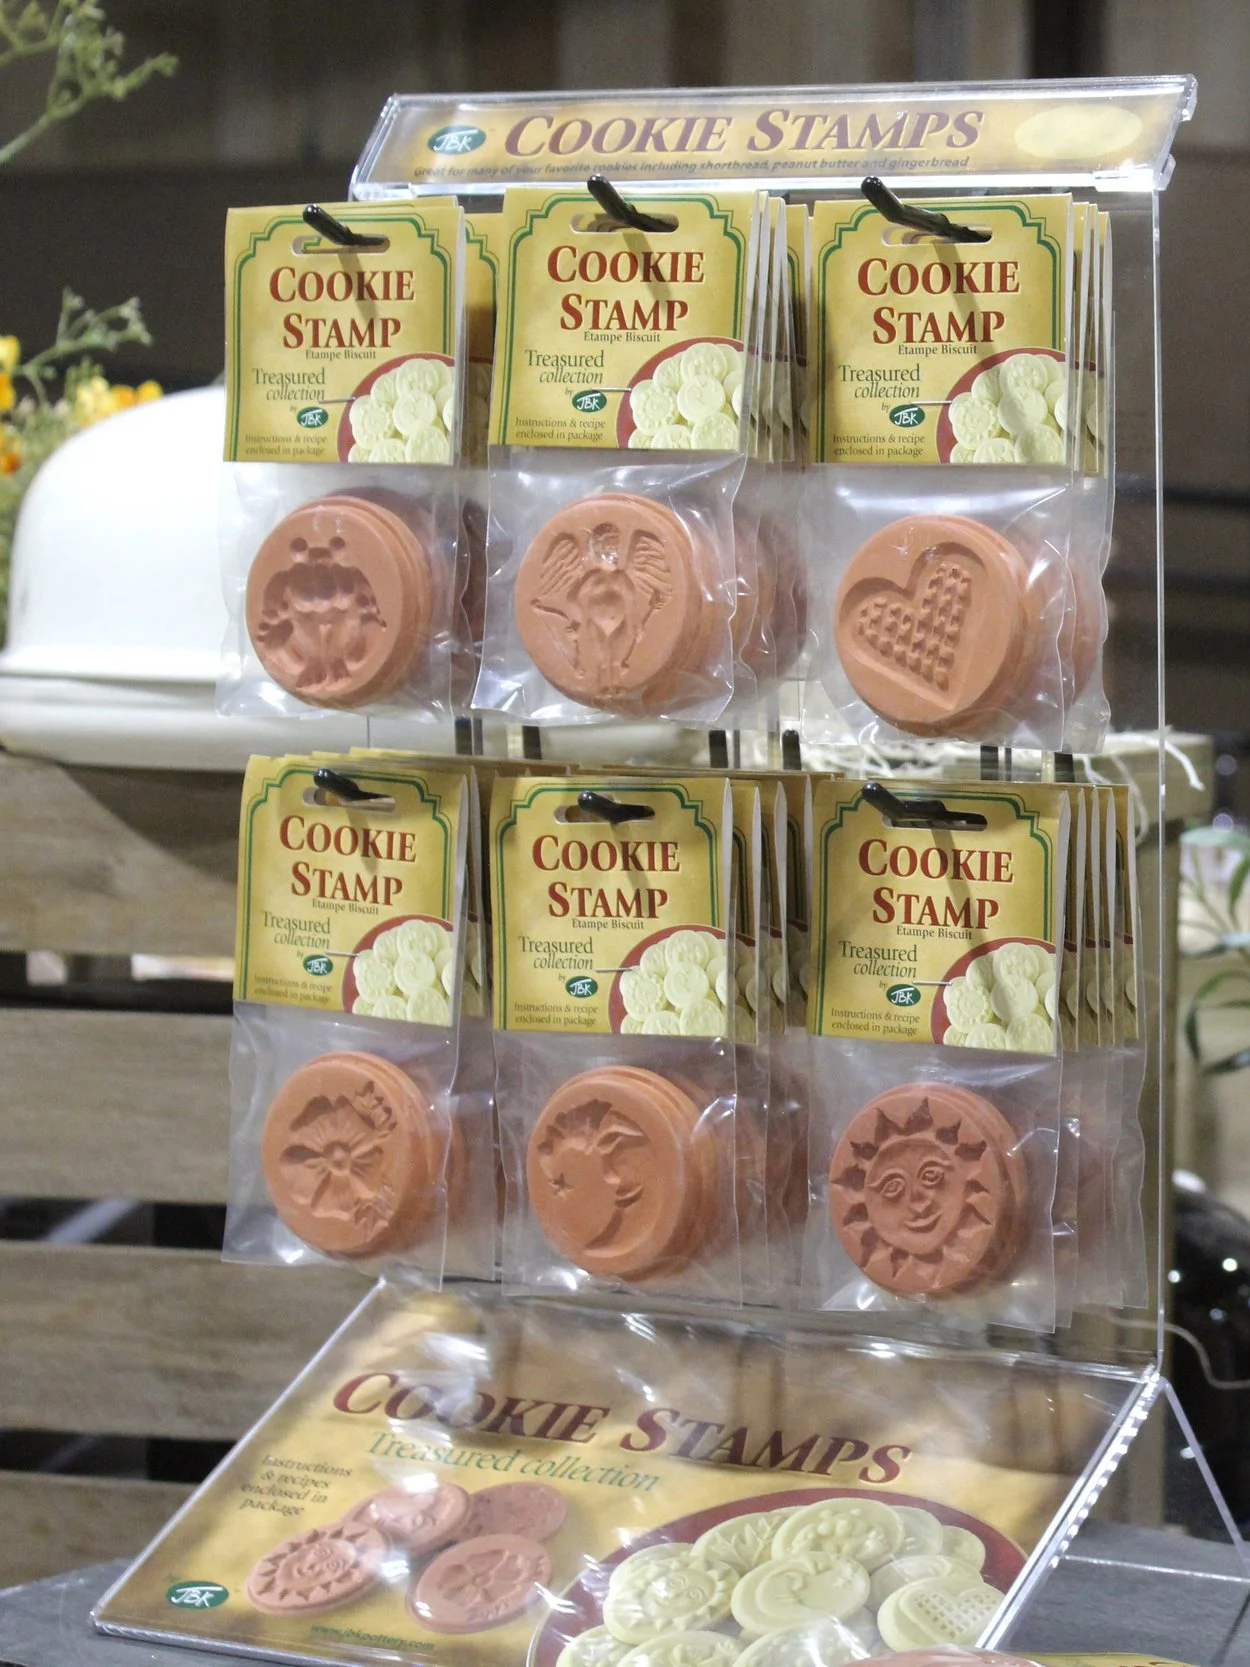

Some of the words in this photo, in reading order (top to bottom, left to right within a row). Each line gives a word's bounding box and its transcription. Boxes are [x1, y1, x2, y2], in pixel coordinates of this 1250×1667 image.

[433, 129, 480, 153] JBK
[505, 114, 732, 157] COOKIE
[747, 110, 984, 151] STAMPS
[545, 162, 591, 174] favorite
[593, 161, 637, 173] cookies
[640, 160, 697, 173] including
[772, 159, 817, 172] peanut
[820, 157, 858, 169] butter
[862, 157, 885, 169] and
[889, 156, 970, 170] gingerbread
[547, 245, 705, 283] COOKIE
[269, 266, 415, 303] COOKIE
[857, 258, 1020, 296] COOKIE
[560, 293, 688, 332] STAMP
[283, 313, 402, 349] STAMP
[873, 306, 1005, 345] STAMP
[625, 331, 661, 342] Biscuit
[344, 349, 376, 360] Biscuit
[524, 349, 604, 367] Treasured
[941, 344, 977, 354] Biscuit
[251, 367, 326, 385] Treasured
[539, 365, 603, 384] collection
[838, 363, 921, 381] Treasured
[266, 382, 325, 400] collection
[854, 381, 920, 399] collection
[575, 392, 603, 411] JBK
[298, 408, 325, 426] JBK
[515, 417, 567, 428] Instructions
[569, 417, 577, 427] &
[579, 417, 605, 430] recipe
[893, 406, 920, 425] JBK
[516, 429, 556, 440] enclosed
[558, 430, 566, 440] in
[567, 430, 603, 442] package
[832, 433, 885, 443] Instructions
[888, 434, 896, 443] &
[898, 433, 925, 446] recipe
[834, 445, 873, 456] enclosed
[875, 446, 884, 456] in
[887, 446, 923, 457] package
[279, 815, 417, 863] COOKIE
[532, 834, 681, 872] COOKIE
[858, 838, 1014, 883] COOKIE
[290, 861, 403, 907] STAMP
[348, 903, 379, 915] Biscuit
[548, 881, 668, 919] STAMP
[872, 886, 999, 931] STAMP
[262, 911, 330, 934] Treasured
[611, 919, 644, 930] Biscuit
[274, 927, 330, 949] collection
[938, 928, 972, 940] Biscuit
[517, 935, 593, 954] Treasured
[838, 940, 918, 962] Treasured
[306, 957, 330, 975] JBK
[533, 952, 593, 969] collection
[853, 960, 917, 978] collection
[568, 977, 593, 996] JBK
[889, 986, 916, 1005] JBK
[514, 1001, 562, 1013] Instructions
[564, 1002, 571, 1012] &
[573, 1003, 598, 1015] recipe
[831, 1008, 881, 1019] Instructions
[884, 1011, 891, 1020] &
[894, 1011, 920, 1024] recipe
[515, 1014, 550, 1024] enclosed
[553, 1014, 561, 1024] in
[563, 1015, 597, 1027] package
[831, 1019, 869, 1031] enclosed
[871, 1022, 880, 1032] in
[883, 1024, 918, 1036] package
[332, 1372, 612, 1444] COOKIE
[619, 1407, 912, 1485] STAMPS
[366, 1431, 521, 1474] Treasured
[521, 1445, 660, 1491] collection
[241, 1483, 311, 1501] enclosed
[310, 1490, 328, 1503] in
[240, 1499, 305, 1517] package
[170, 1583, 225, 1608] JBK
